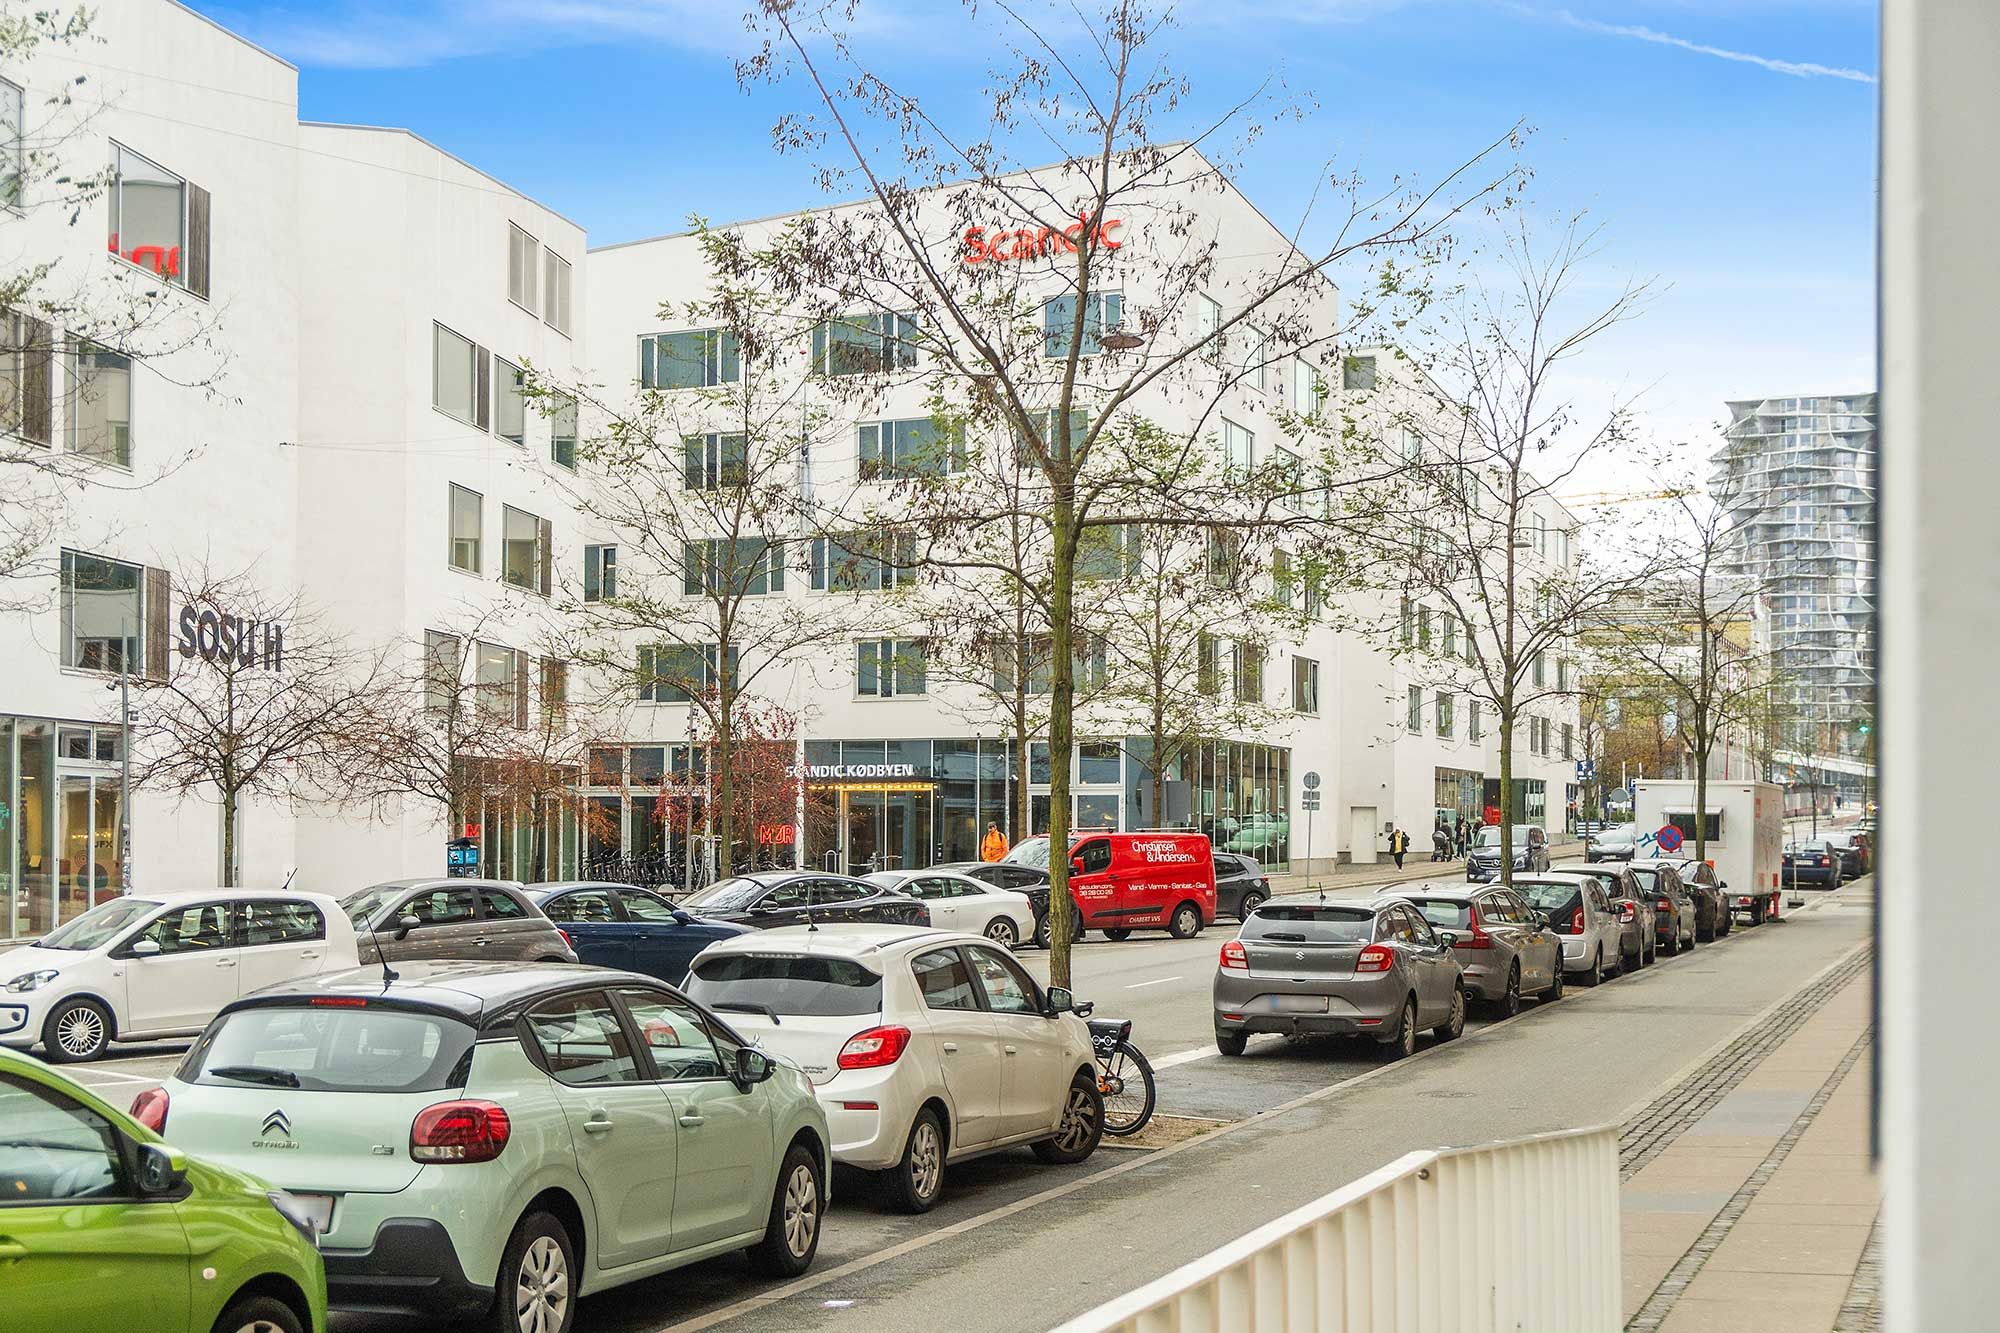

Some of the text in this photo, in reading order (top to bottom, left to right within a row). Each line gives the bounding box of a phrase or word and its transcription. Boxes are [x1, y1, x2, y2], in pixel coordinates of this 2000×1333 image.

[963, 211, 1121, 263] Scandic
[178, 605, 282, 672] SOSU H
[847, 763, 914, 777] KØDBYEN
